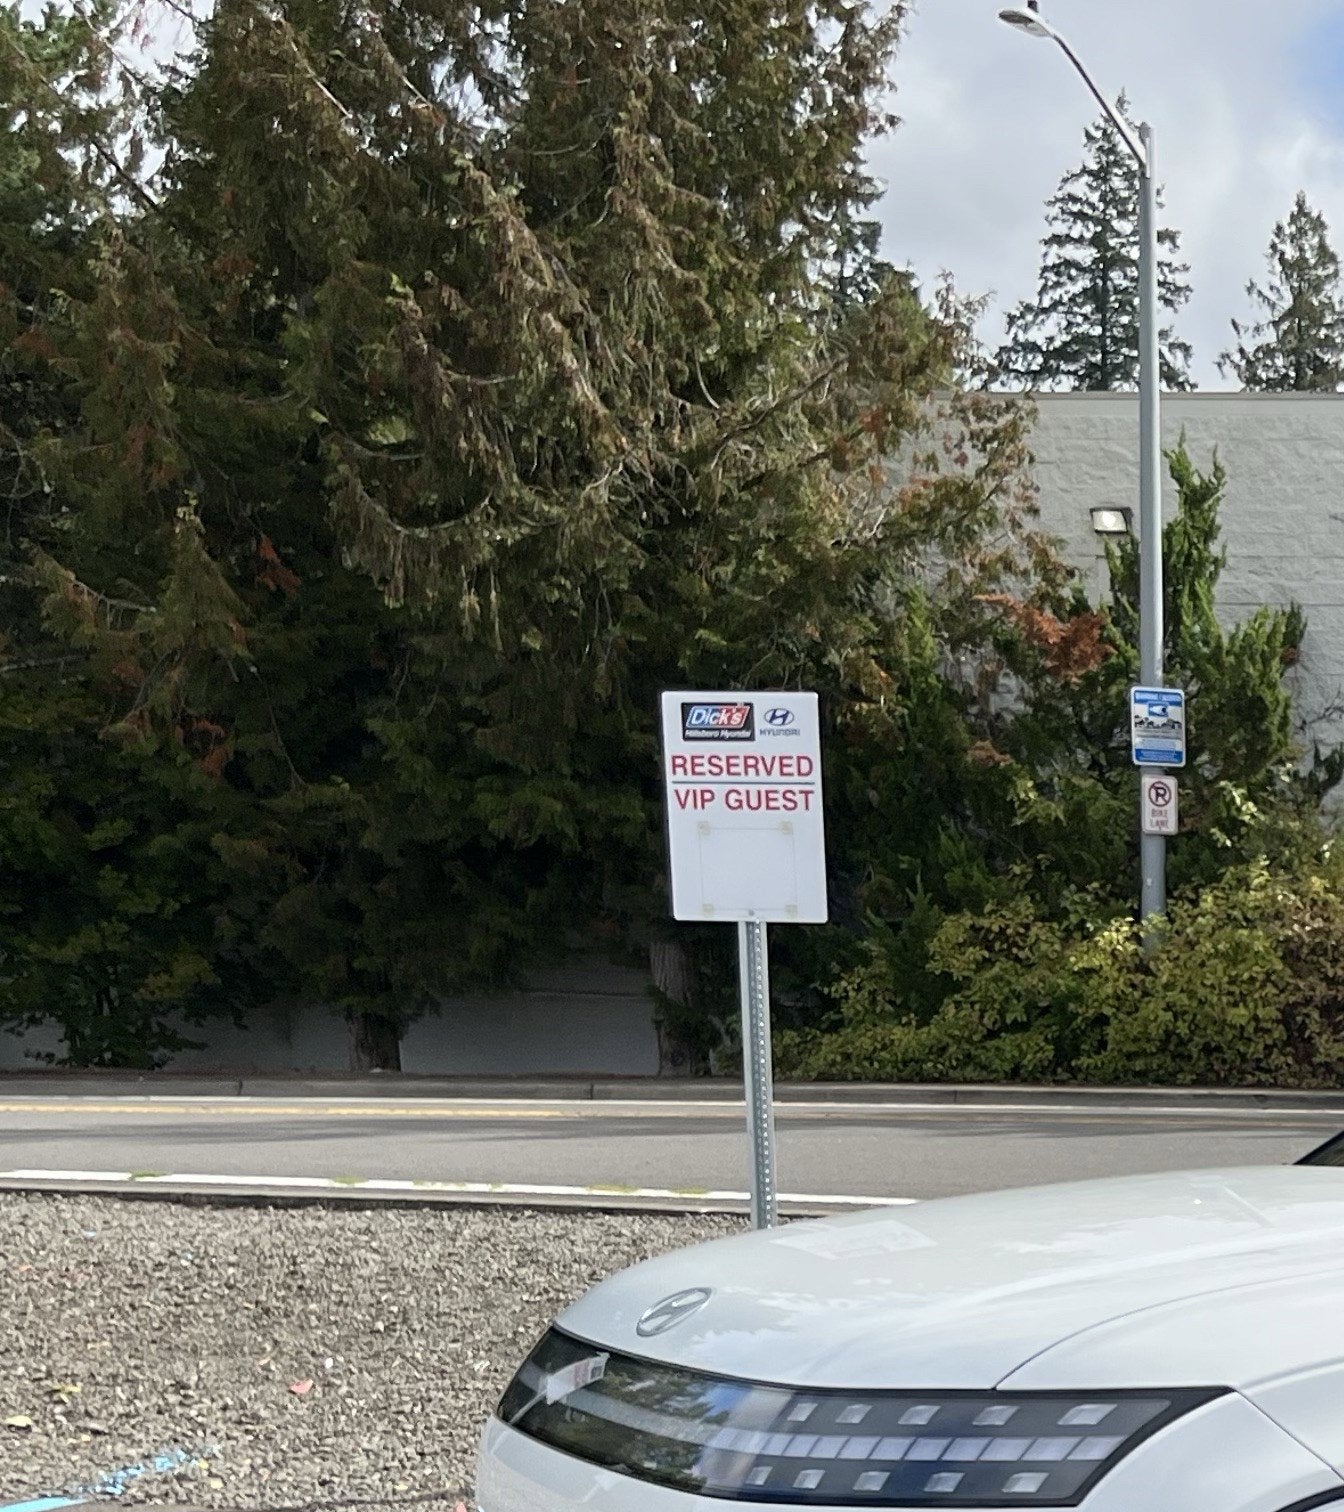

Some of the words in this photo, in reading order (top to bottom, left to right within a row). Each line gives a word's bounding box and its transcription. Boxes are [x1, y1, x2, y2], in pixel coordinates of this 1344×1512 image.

[691, 706, 743, 726] Dick's
[760, 728, 800, 737] HYUNDAI
[671, 754, 814, 777] RESERVED
[673, 788, 715, 811] VIP
[725, 788, 815, 811] GUEST
